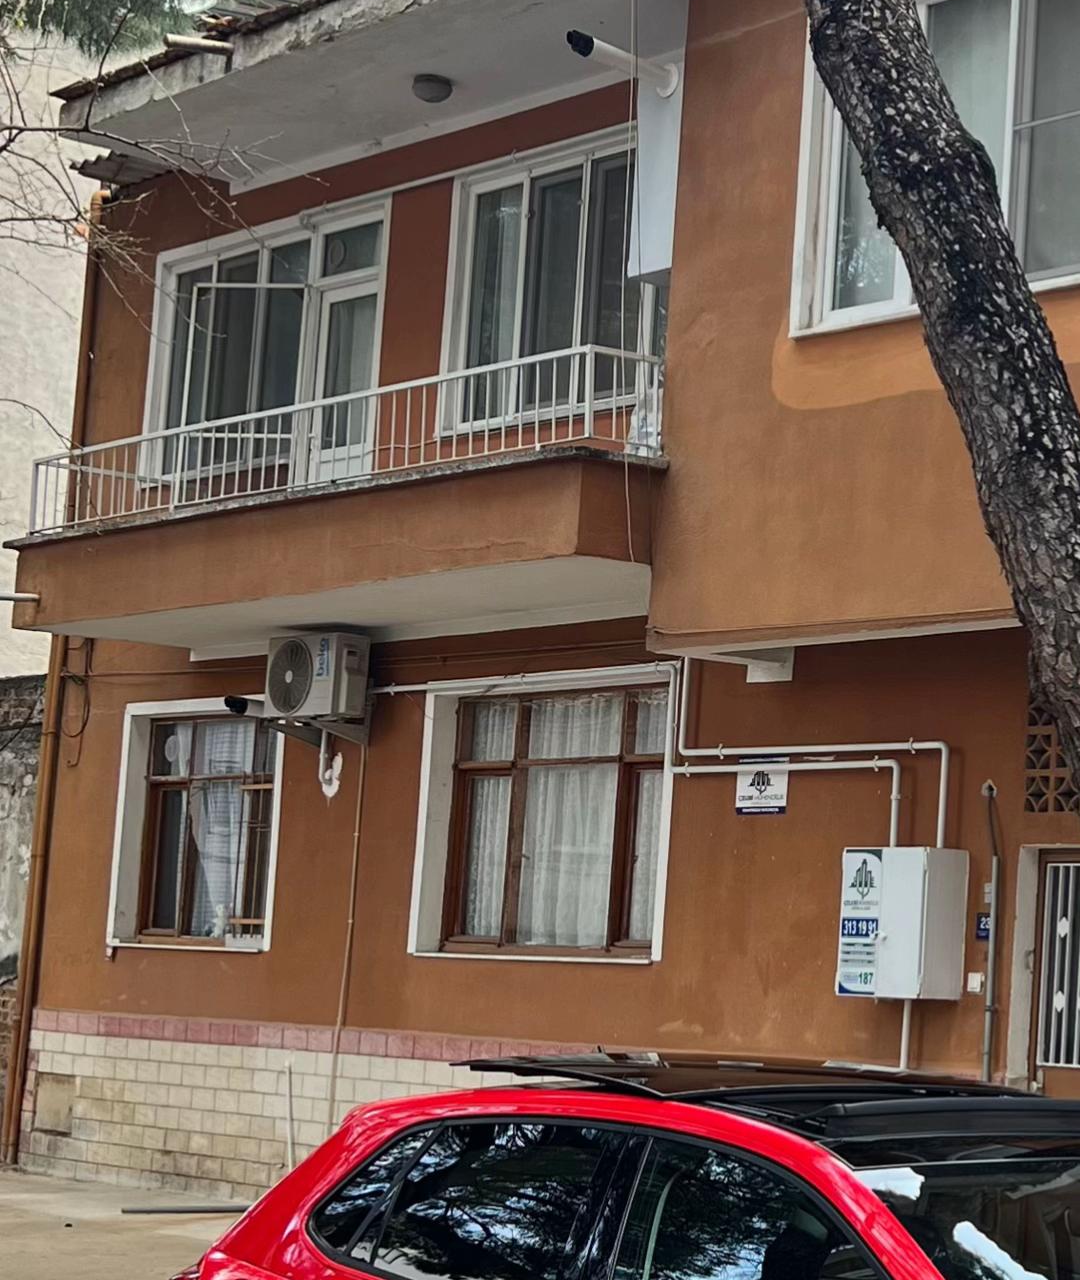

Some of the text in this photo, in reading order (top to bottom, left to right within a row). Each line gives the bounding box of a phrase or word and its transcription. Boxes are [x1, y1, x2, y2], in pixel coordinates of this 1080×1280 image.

[316, 638, 329, 677] beko
[843, 920, 877, 935] 313 19 91
[859, 972, 874, 985] 187
